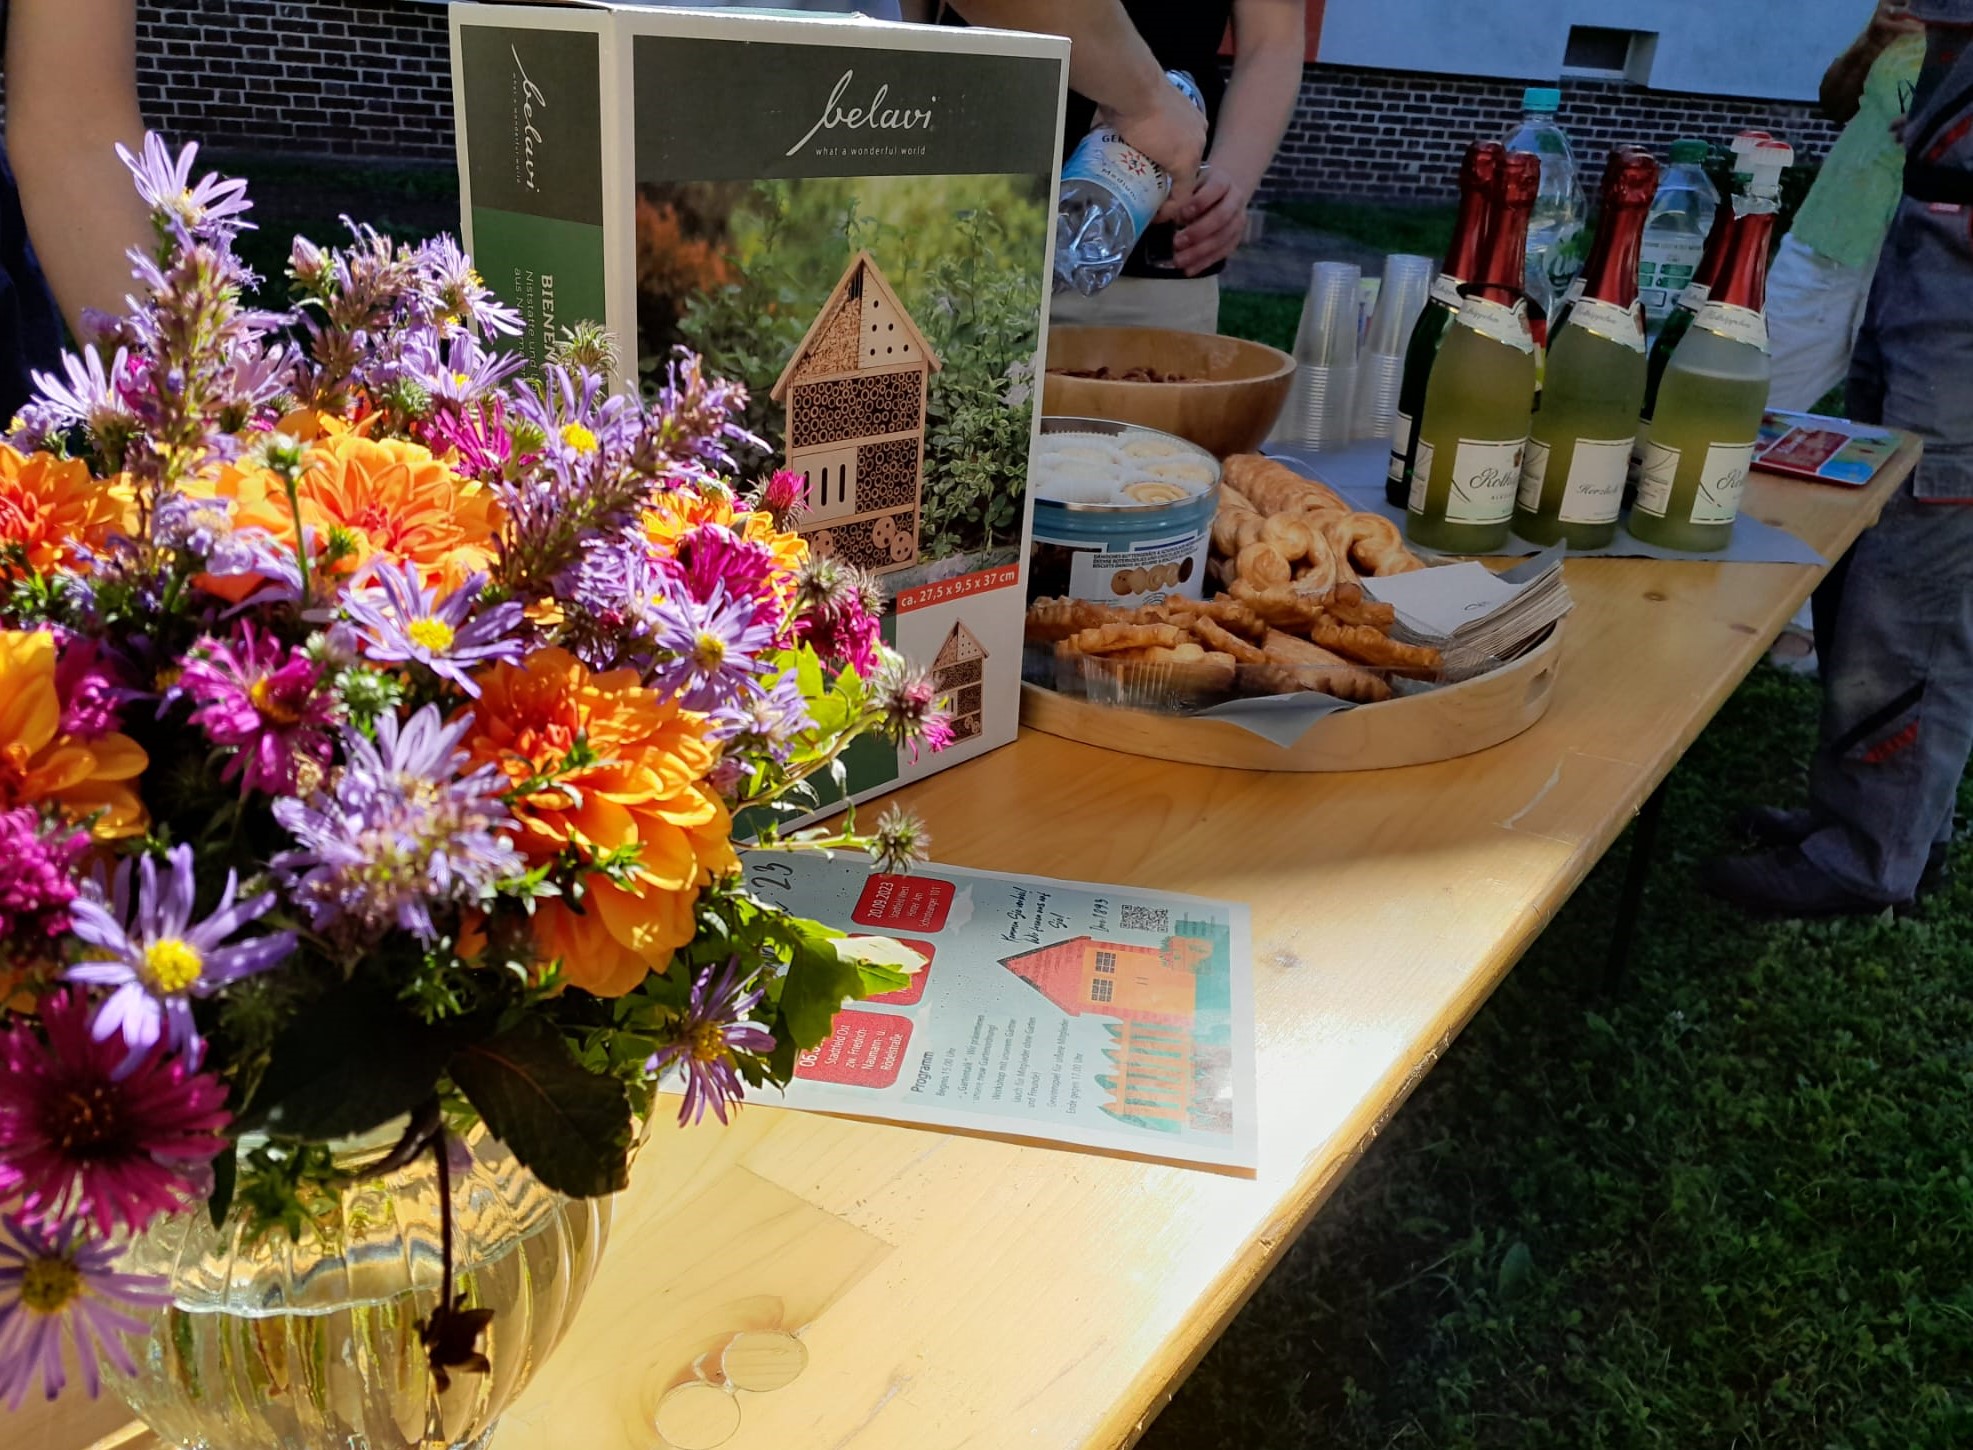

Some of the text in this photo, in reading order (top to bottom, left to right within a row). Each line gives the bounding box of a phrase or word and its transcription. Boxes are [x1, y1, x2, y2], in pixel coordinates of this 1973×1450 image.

[511, 42, 547, 193] belavi
[785, 69, 936, 156] belavi
[815, 145, 926, 156] what a wonderful world
[514, 267, 522, 292] aus
[529, 342, 538, 368] und
[901, 571, 1015, 607] ca. 27,5 x 9,5 x 37 cm
[824, 1024, 852, 1064] Stadtfeld Ost
[911, 1051, 934, 1093] Programm
